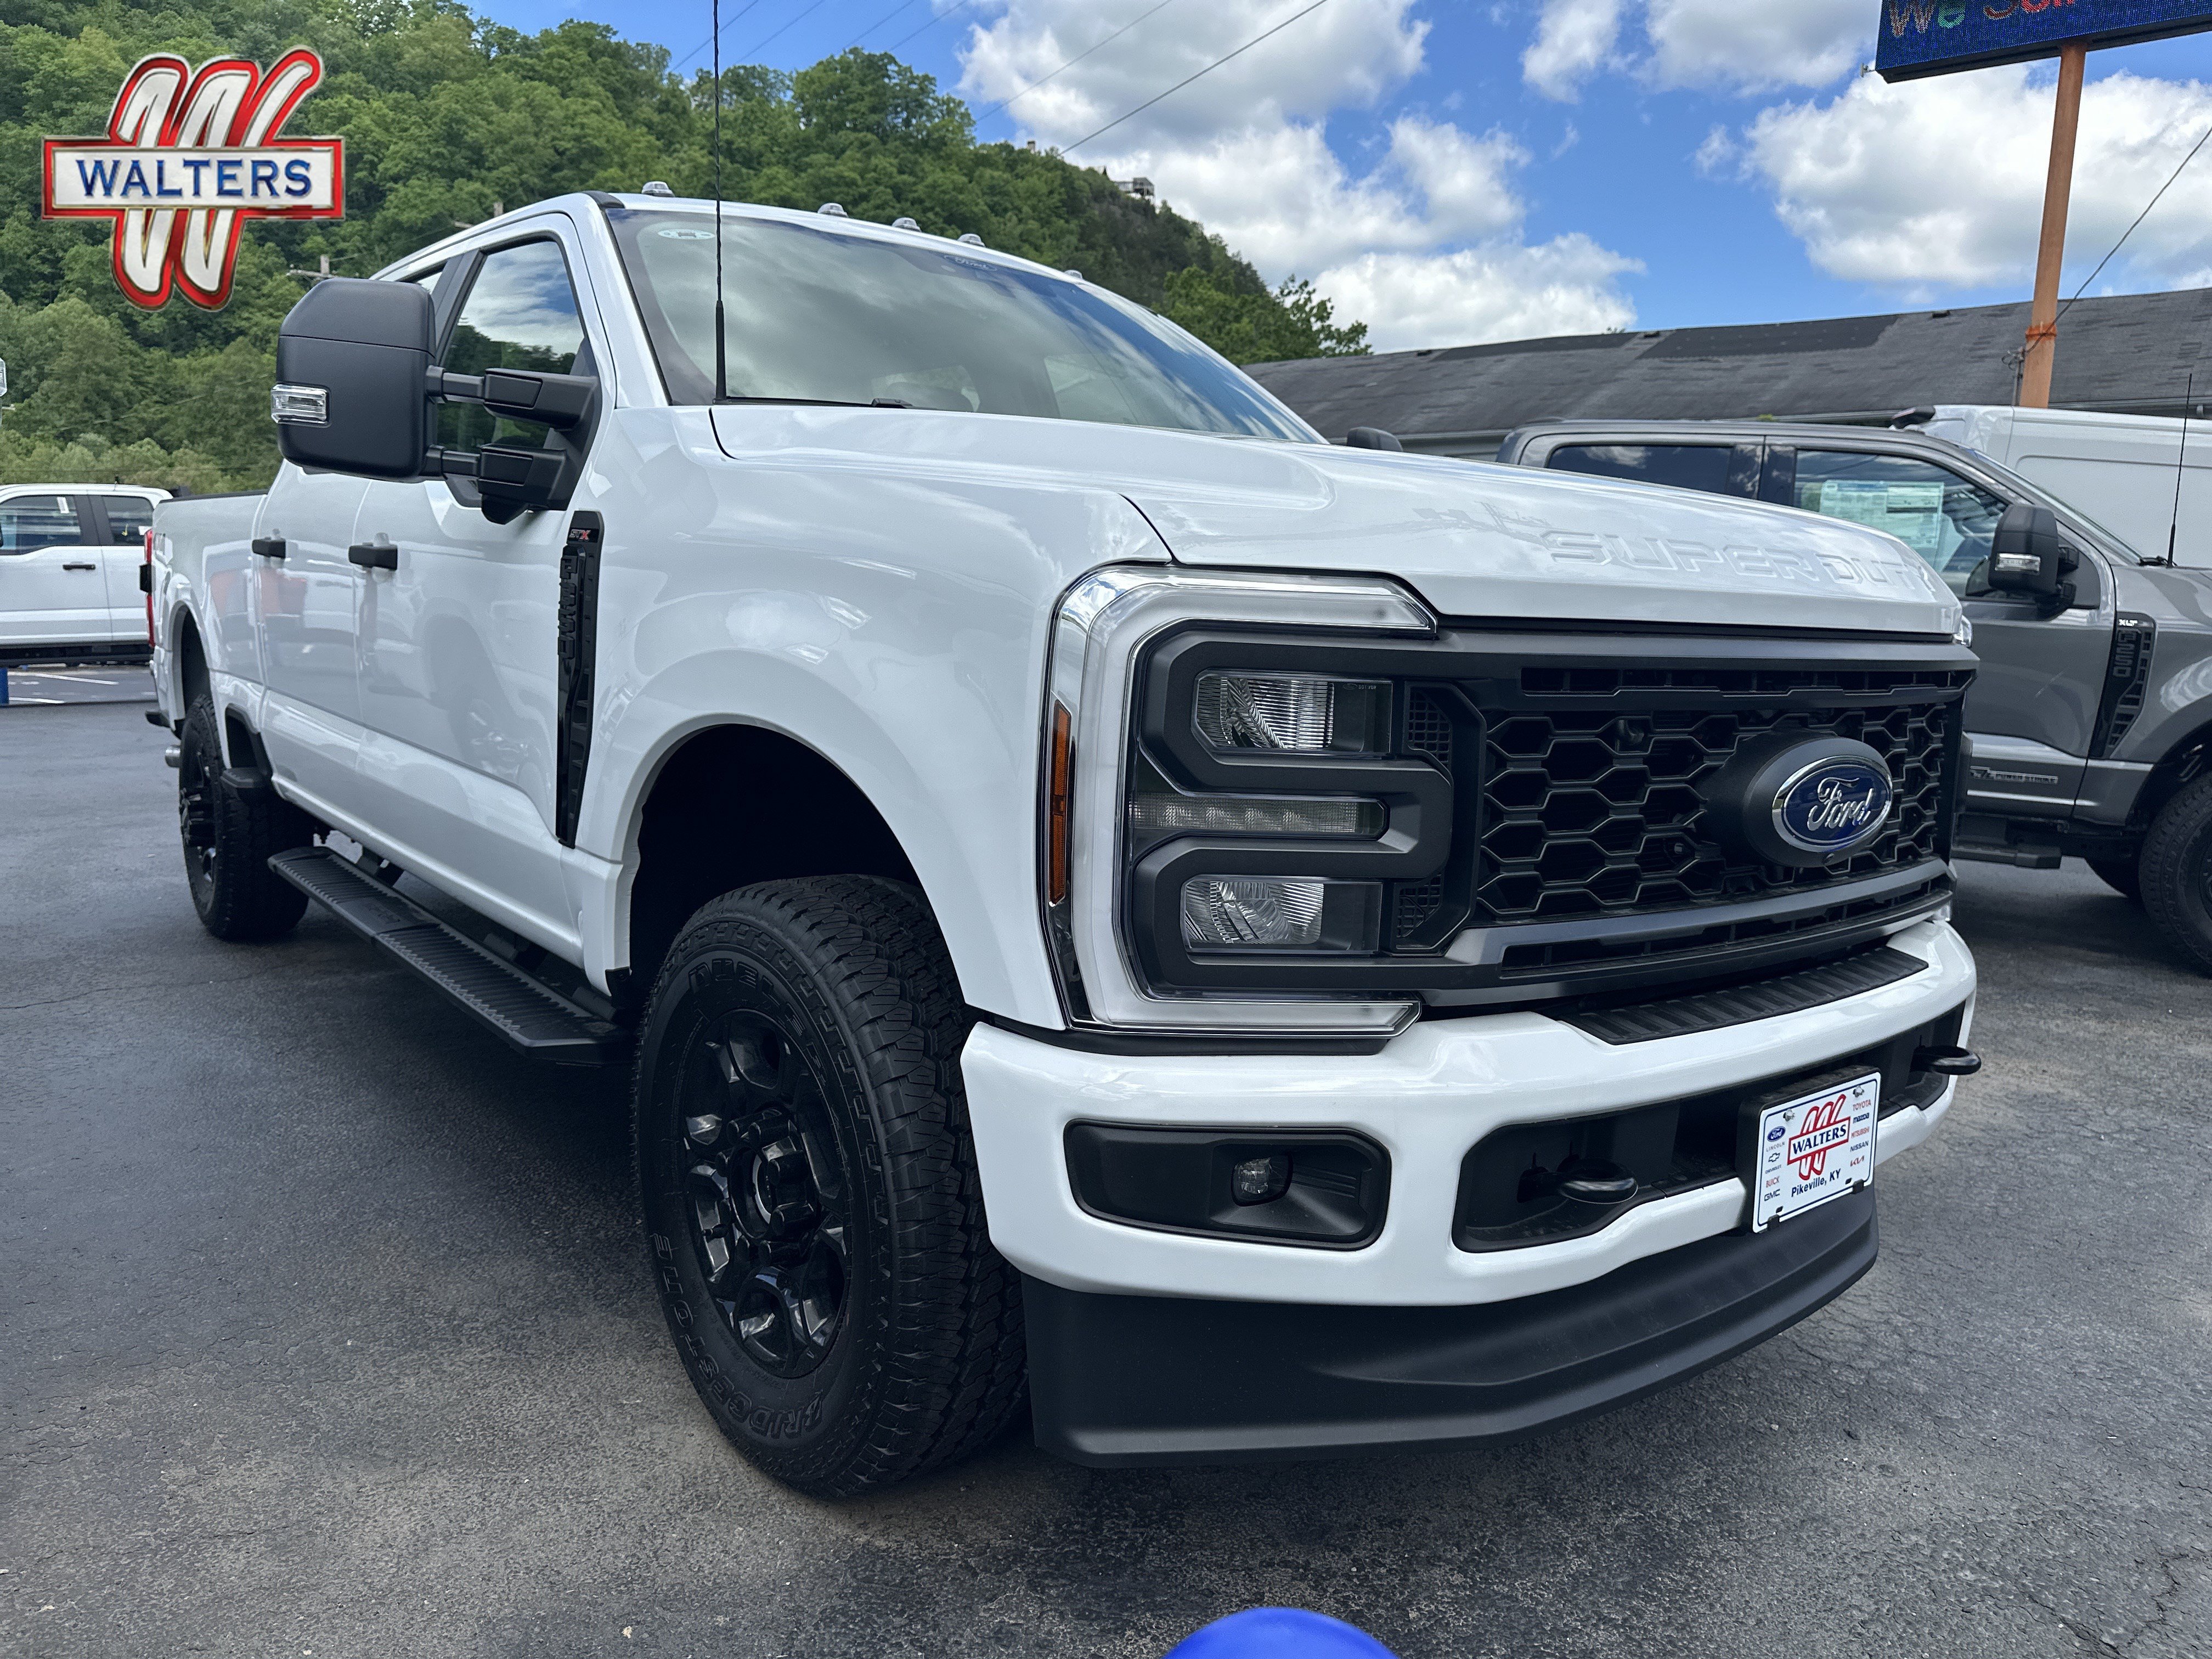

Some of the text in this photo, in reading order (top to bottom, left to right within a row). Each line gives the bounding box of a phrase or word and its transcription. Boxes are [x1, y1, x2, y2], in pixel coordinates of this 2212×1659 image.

[568, 528, 592, 541] STX
[1539, 529, 1937, 592] SUPER DUTY
[2112, 630, 2136, 678] F250
[1807, 776, 1875, 832] Ford
[1853, 1099, 1871, 1111] TOYOTA
[1769, 1127, 1784, 1141] Ford
[1792, 1124, 1847, 1154] WALTERS
[1766, 1142, 1785, 1152] LINCOLN
[1850, 1141, 1869, 1152] NISSAN
[1850, 1155, 1865, 1167] KIA
[1766, 1176, 1780, 1188] BUICK
[1791, 1168, 1842, 1197] Pikeville, KY
[1764, 1189, 1781, 1201] GMC
